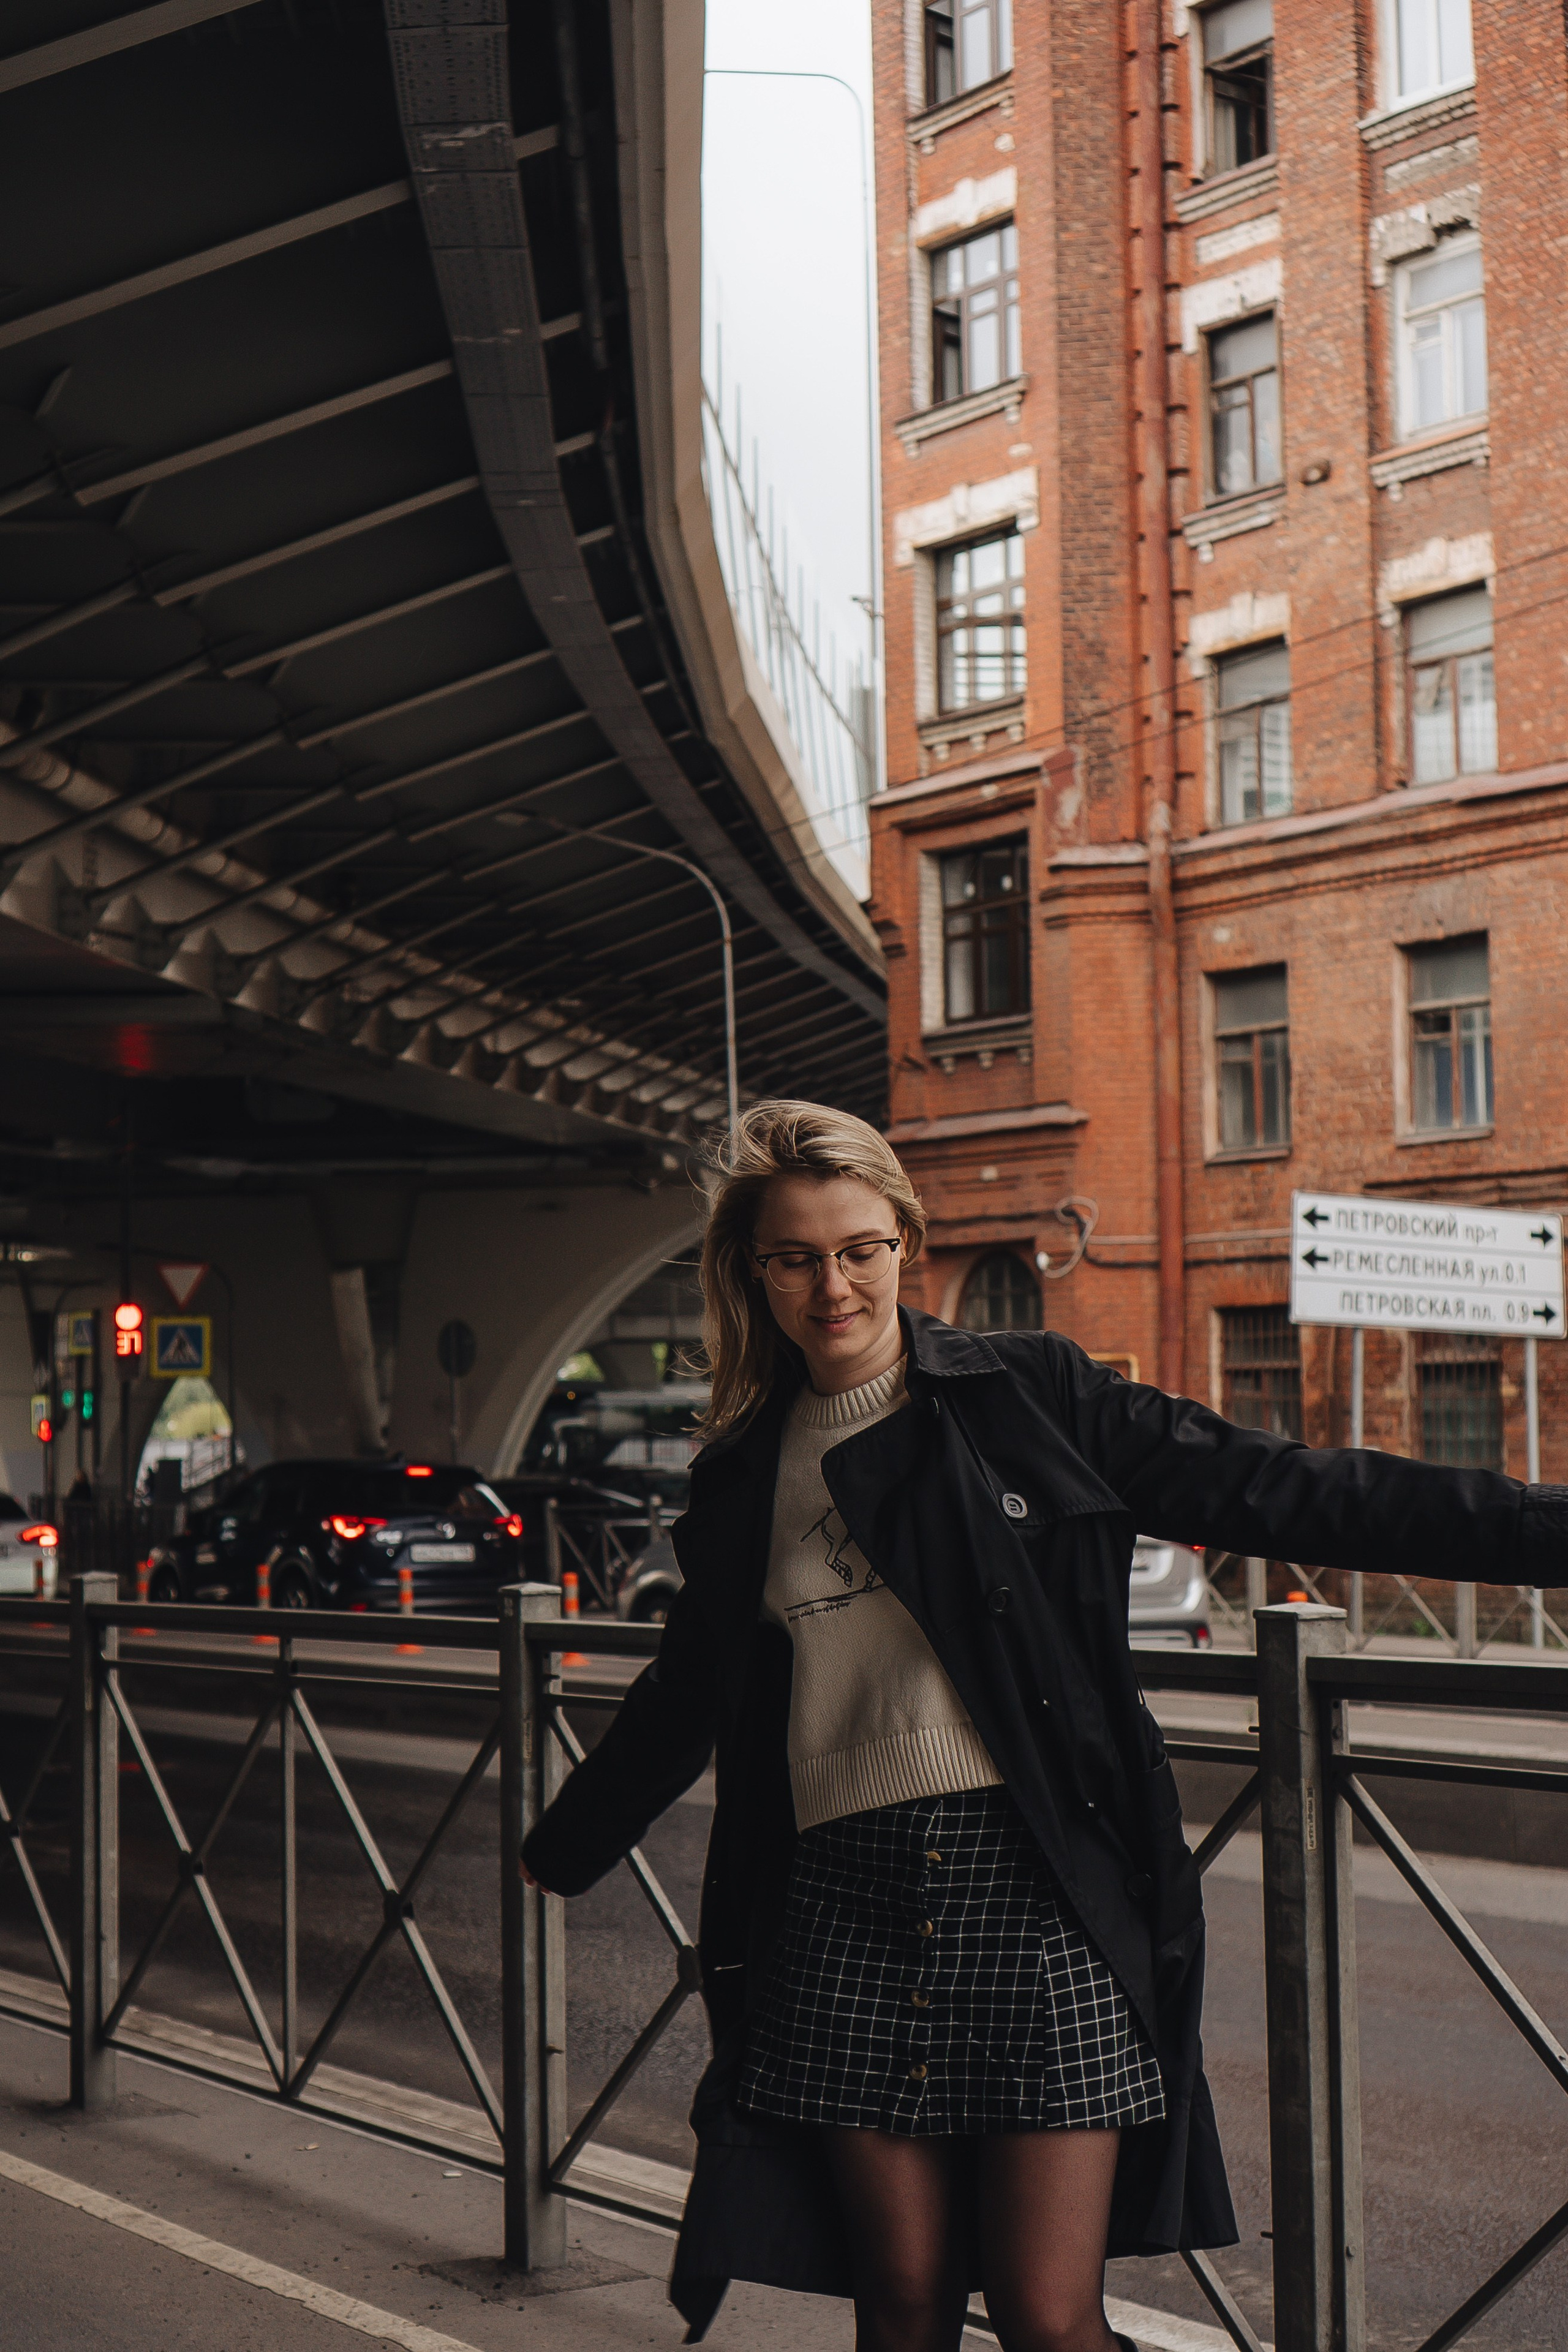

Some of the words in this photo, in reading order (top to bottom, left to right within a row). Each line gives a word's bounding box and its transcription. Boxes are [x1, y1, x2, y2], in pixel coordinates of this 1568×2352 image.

[1336, 1208, 1458, 1238] ПЕТРОВСКИЙ
[1465, 1225, 1498, 1244] пр-т
[1333, 1249, 1474, 1280] РЕМЕСЛЕННАЯ
[1341, 1292, 1465, 1319] ПЕТРОВСКАЯ
